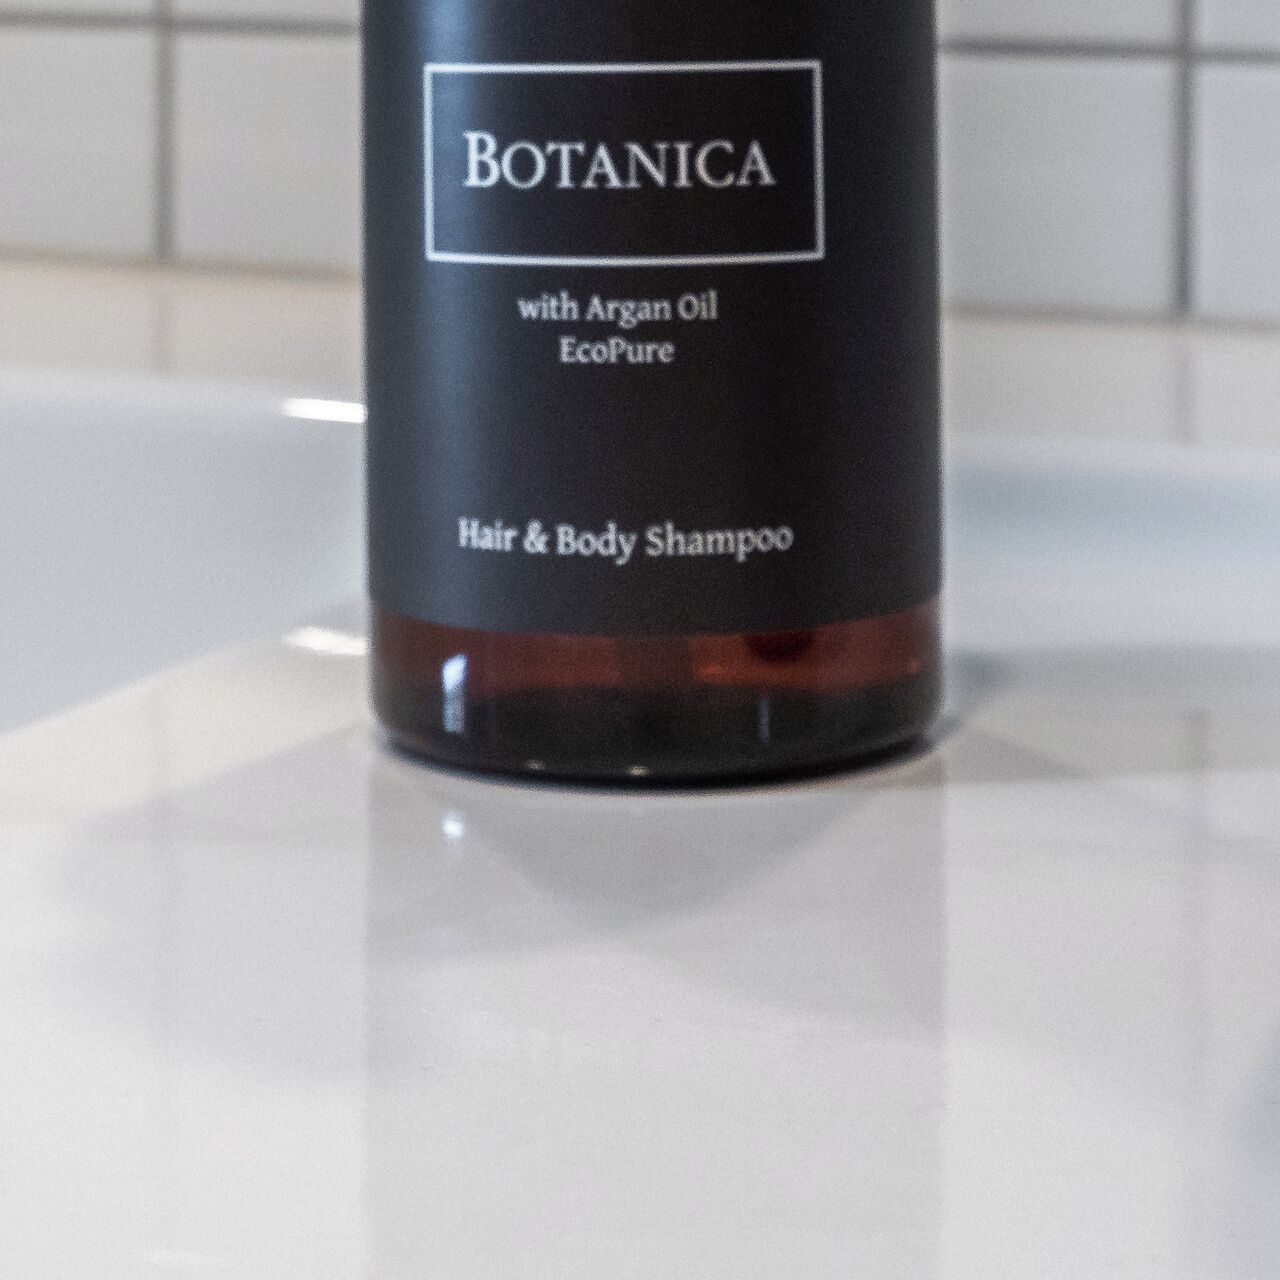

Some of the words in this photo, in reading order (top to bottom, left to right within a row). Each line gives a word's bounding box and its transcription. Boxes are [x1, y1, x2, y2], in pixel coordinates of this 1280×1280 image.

[517, 290, 579, 321] with
[586, 294, 671, 330] Argan
[677, 288, 719, 321] Oil
[559, 335, 675, 365] EcoPure
[457, 516, 517, 553] Hair
[523, 521, 551, 555] &
[556, 523, 637, 566] Body
[645, 522, 795, 562] Shampoo
